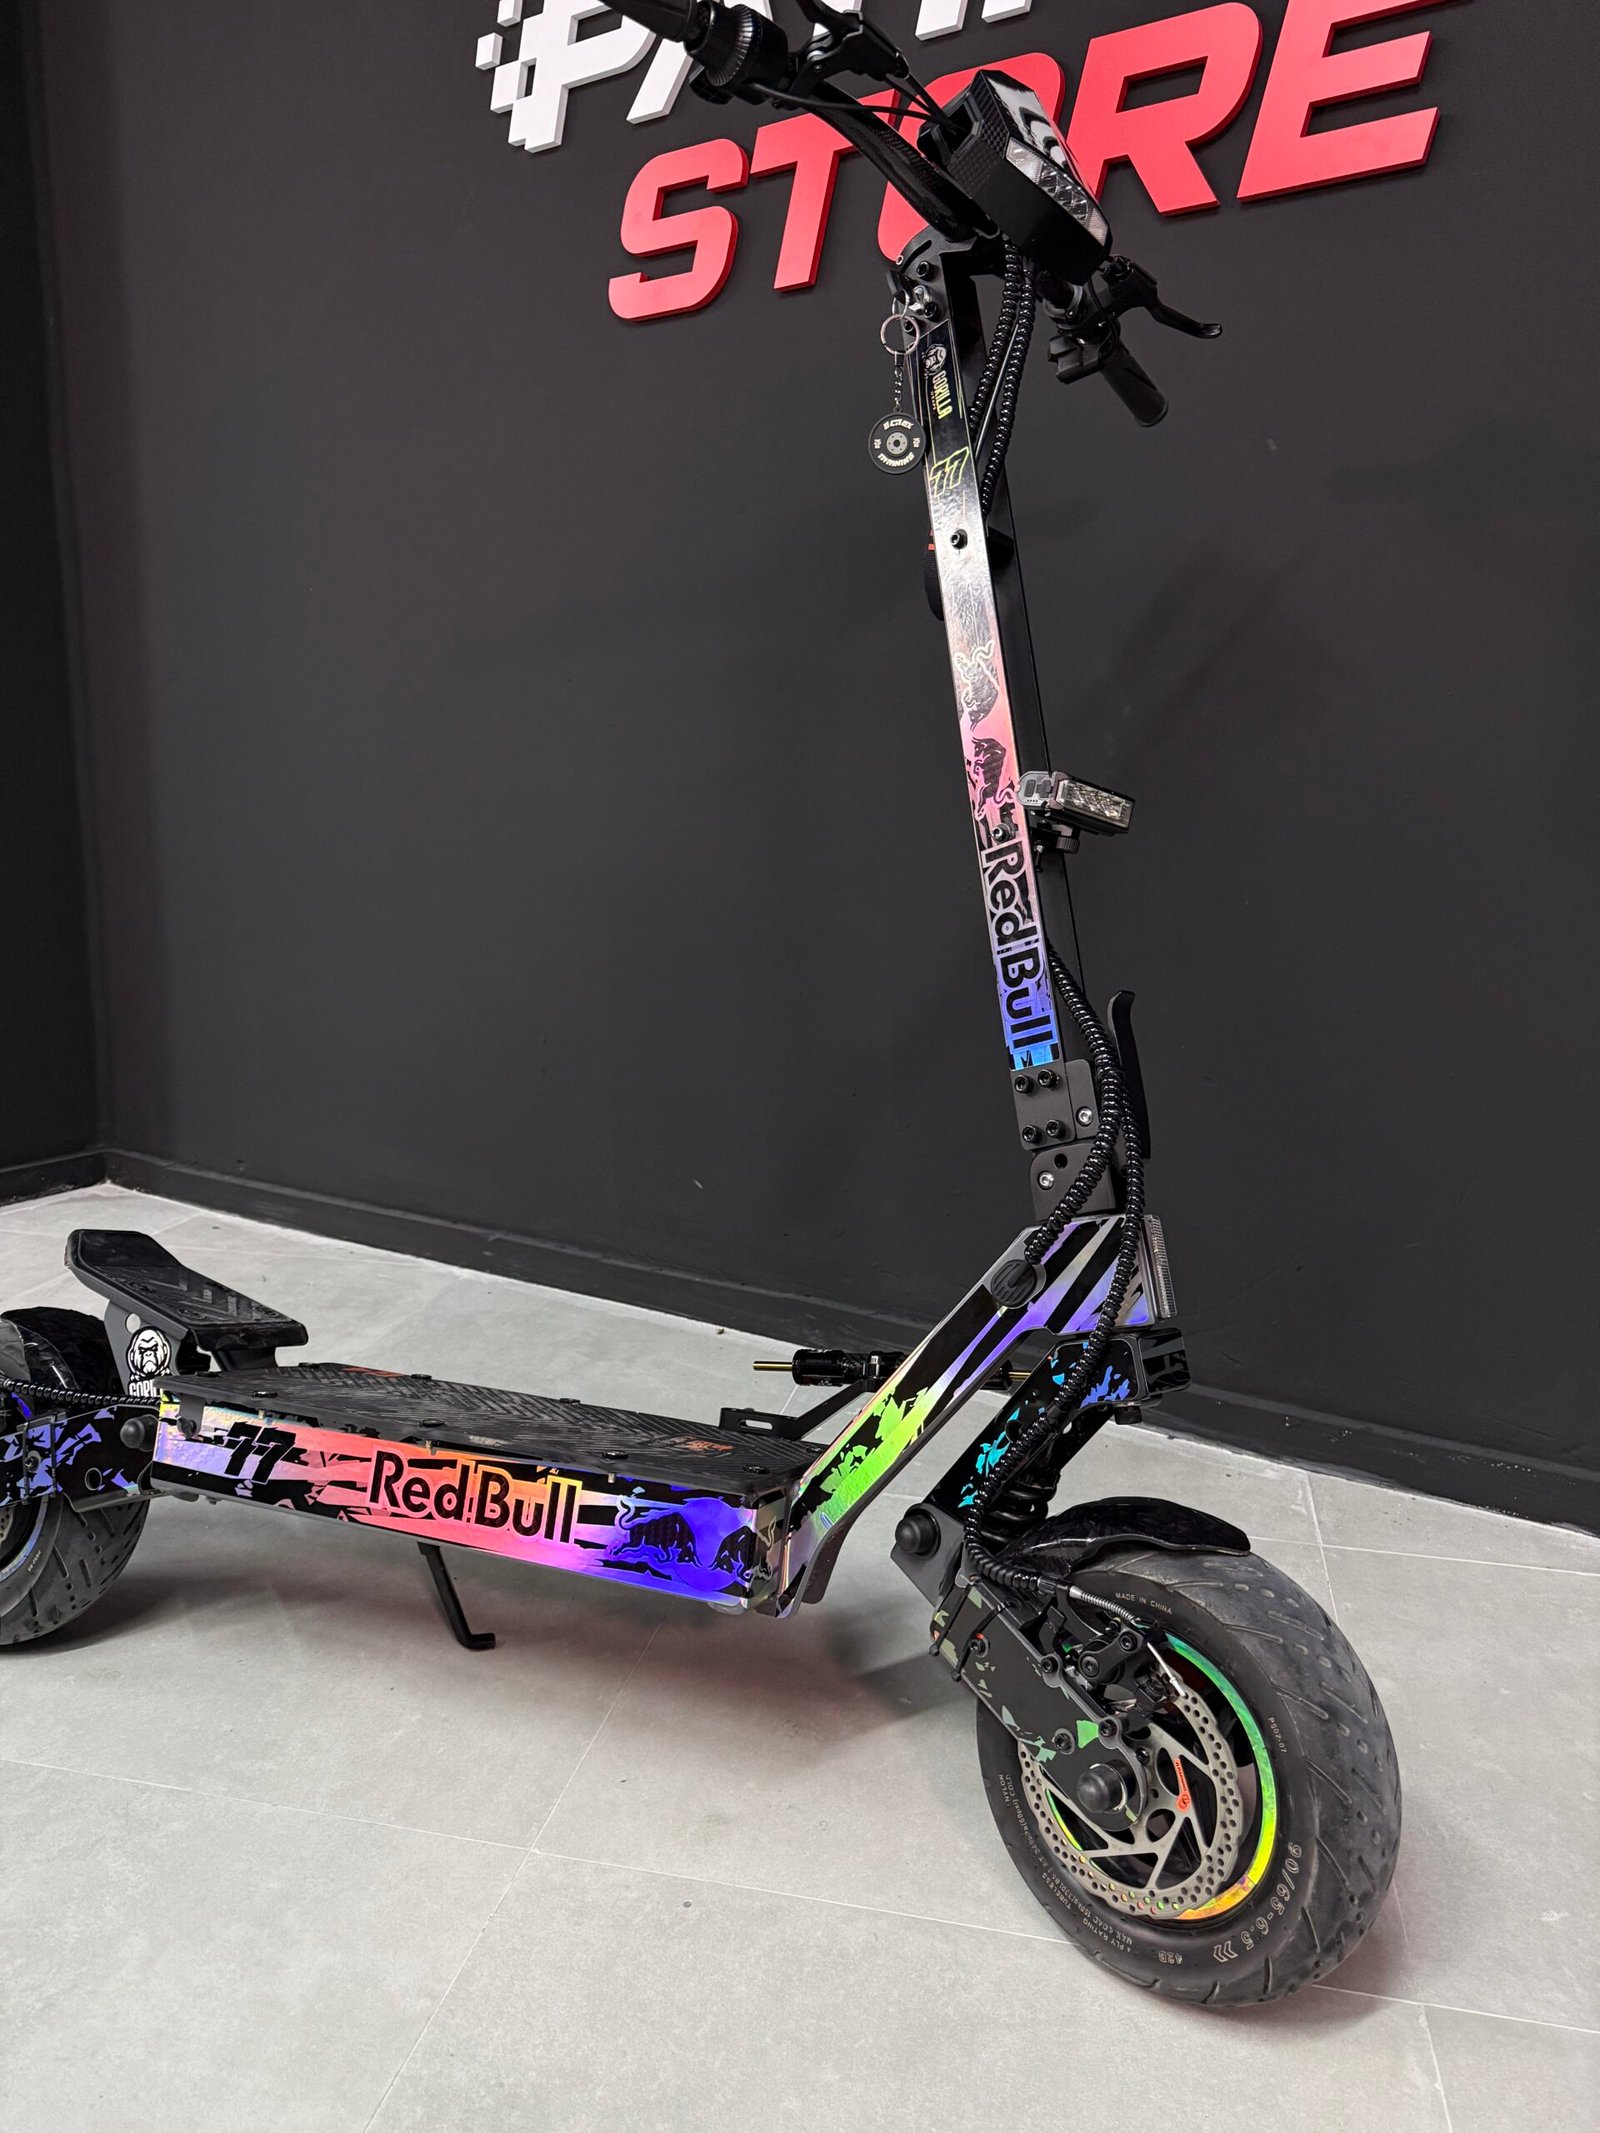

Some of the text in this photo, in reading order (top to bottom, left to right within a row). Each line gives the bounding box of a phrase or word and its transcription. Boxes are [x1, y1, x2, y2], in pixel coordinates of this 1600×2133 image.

[932, 370, 953, 419] GORILLA
[223, 1422, 296, 1483] 77
[1116, 1592, 1172, 1615] MADE IN CHINA
[998, 1774, 1010, 1802] NYLON
[1041, 1872, 1073, 1909] TUBELESS
[1241, 1842, 1302, 1951] 90/65-6.5
[1082, 1917, 1109, 1941] RATING
[1110, 1939, 1125, 1951] PLY
